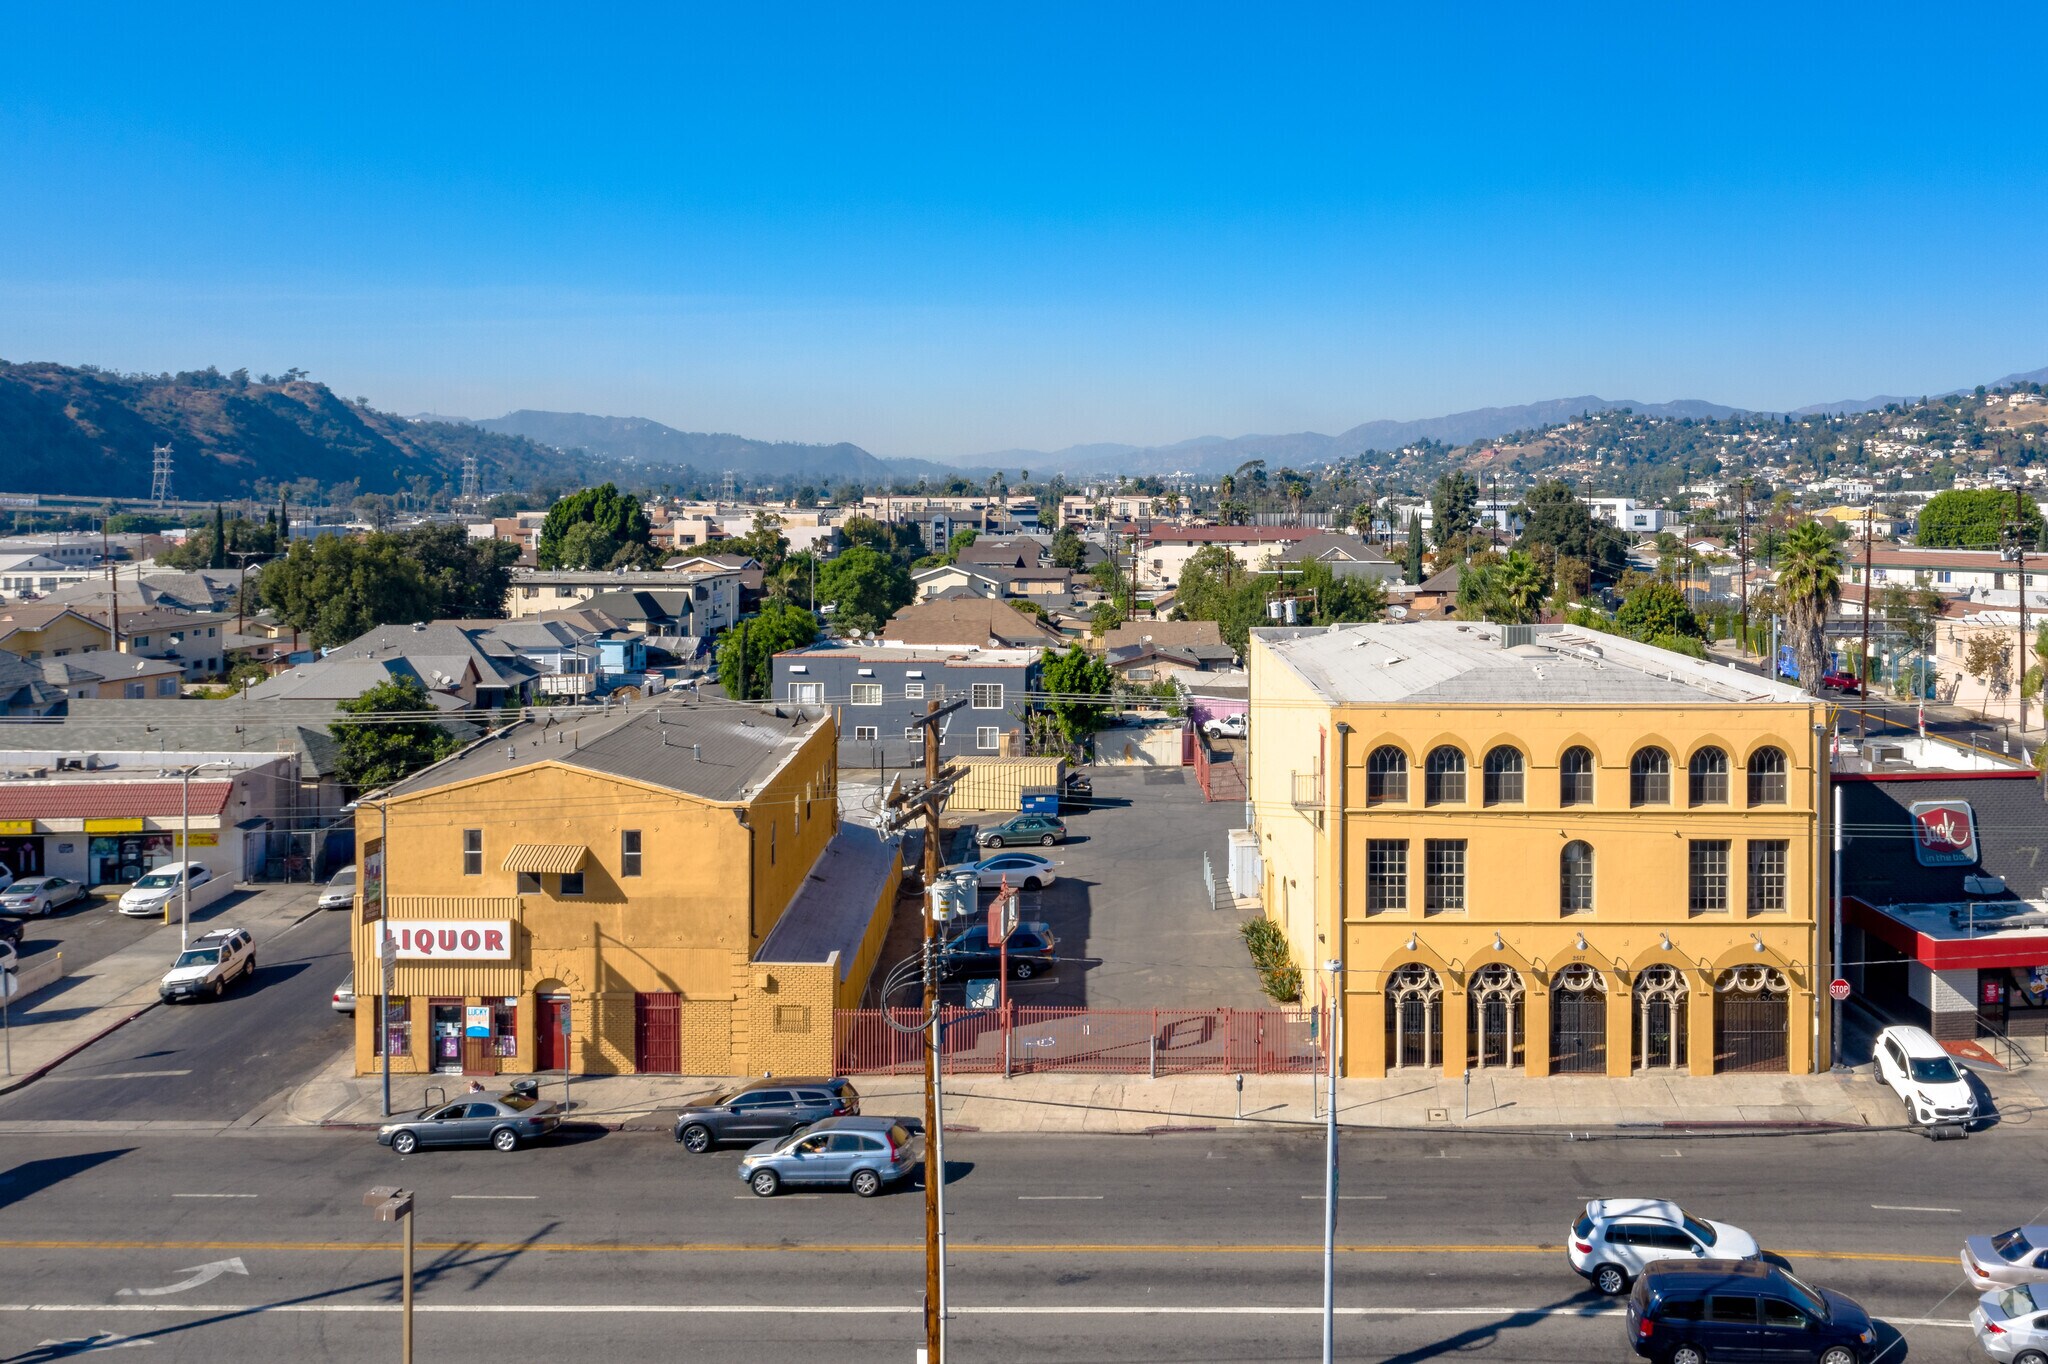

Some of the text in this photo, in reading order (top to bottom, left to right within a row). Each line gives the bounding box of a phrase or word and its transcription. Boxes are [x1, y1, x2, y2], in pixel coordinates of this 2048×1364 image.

[1921, 812, 1968, 846] Jack
[1926, 854, 1935, 862] in
[1936, 854, 1952, 862] the
[1831, 985, 1849, 994] STOP
[468, 1008, 487, 1016] LUCKY
